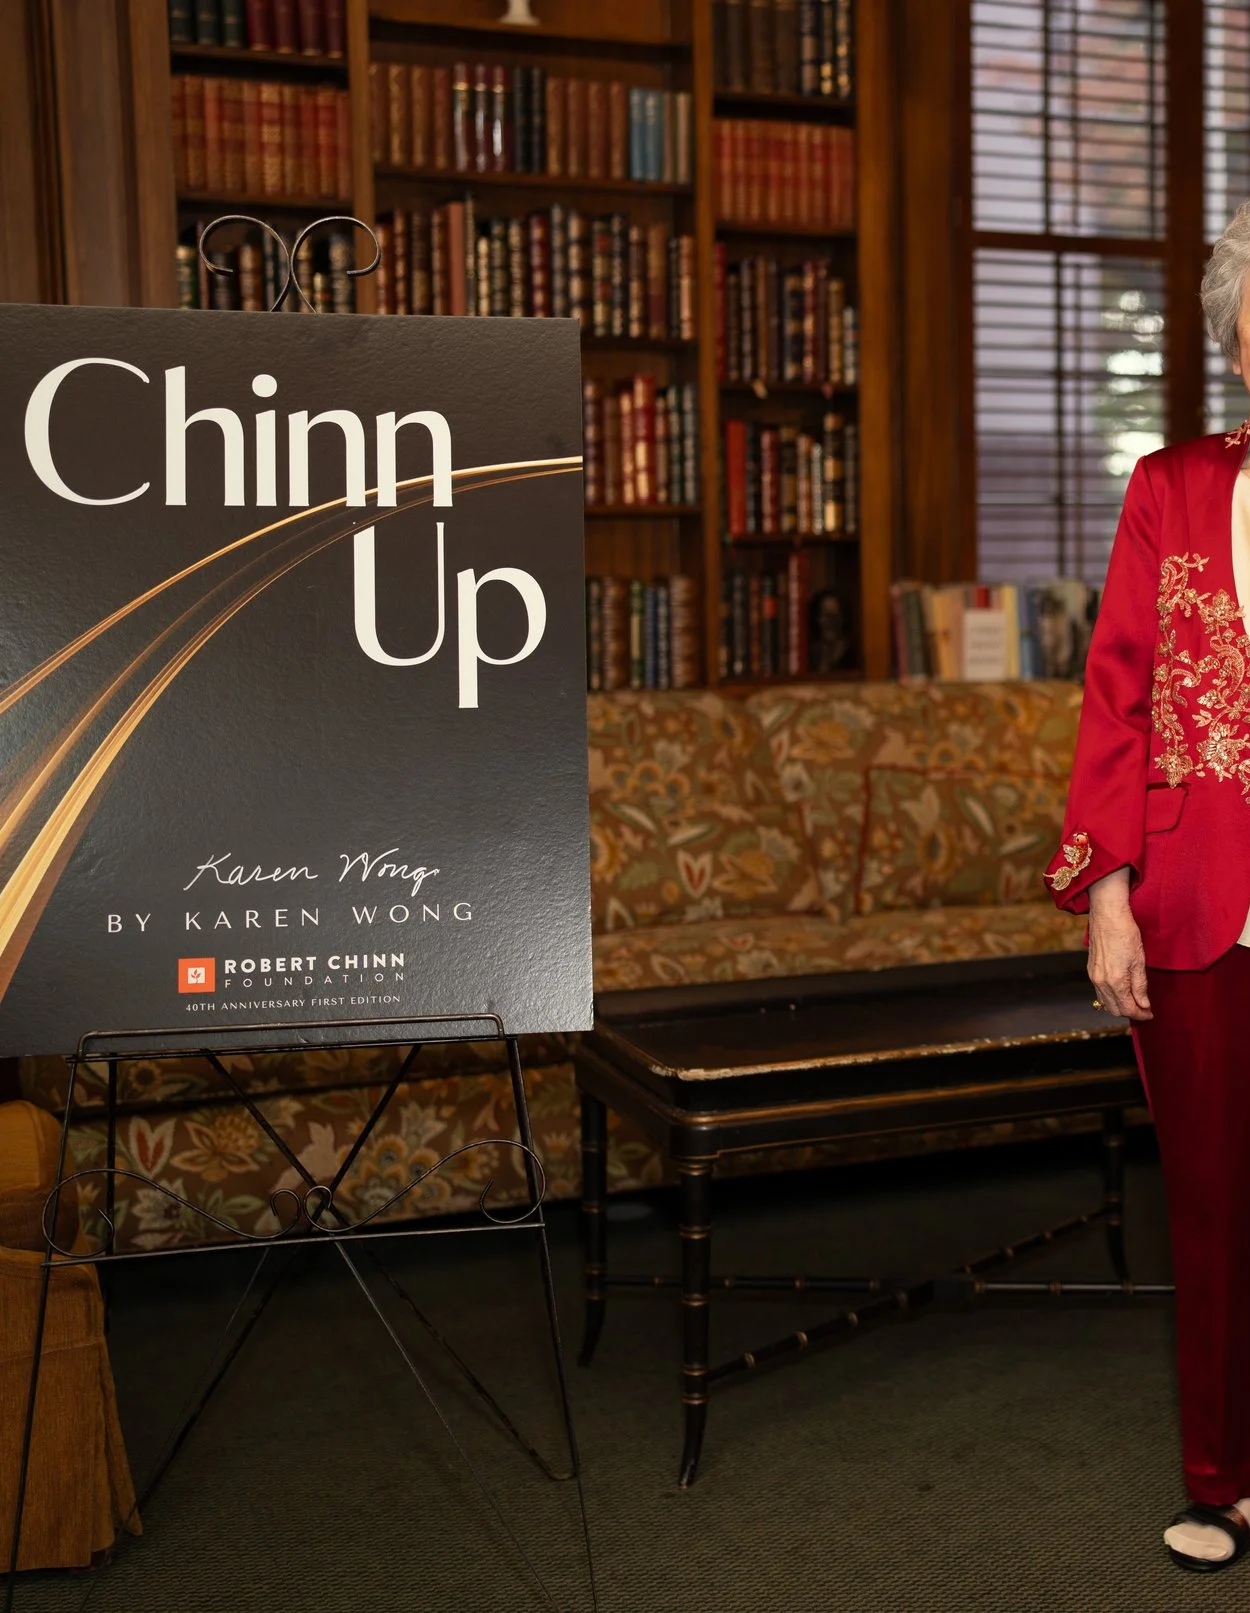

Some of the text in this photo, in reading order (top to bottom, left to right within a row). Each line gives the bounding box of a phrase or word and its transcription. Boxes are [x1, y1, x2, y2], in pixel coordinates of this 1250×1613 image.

[24, 357, 454, 508] Chinn
[352, 521, 547, 709] Up
[182, 852, 319, 891] Karen
[107, 902, 472, 933] BY KAREN WONG
[224, 952, 405, 974] ROBERT CHINN
[224, 973, 405, 989] FOUNDATION
[185, 995, 401, 1012] 40TH ANNIVERSARY FIRST EDITION
